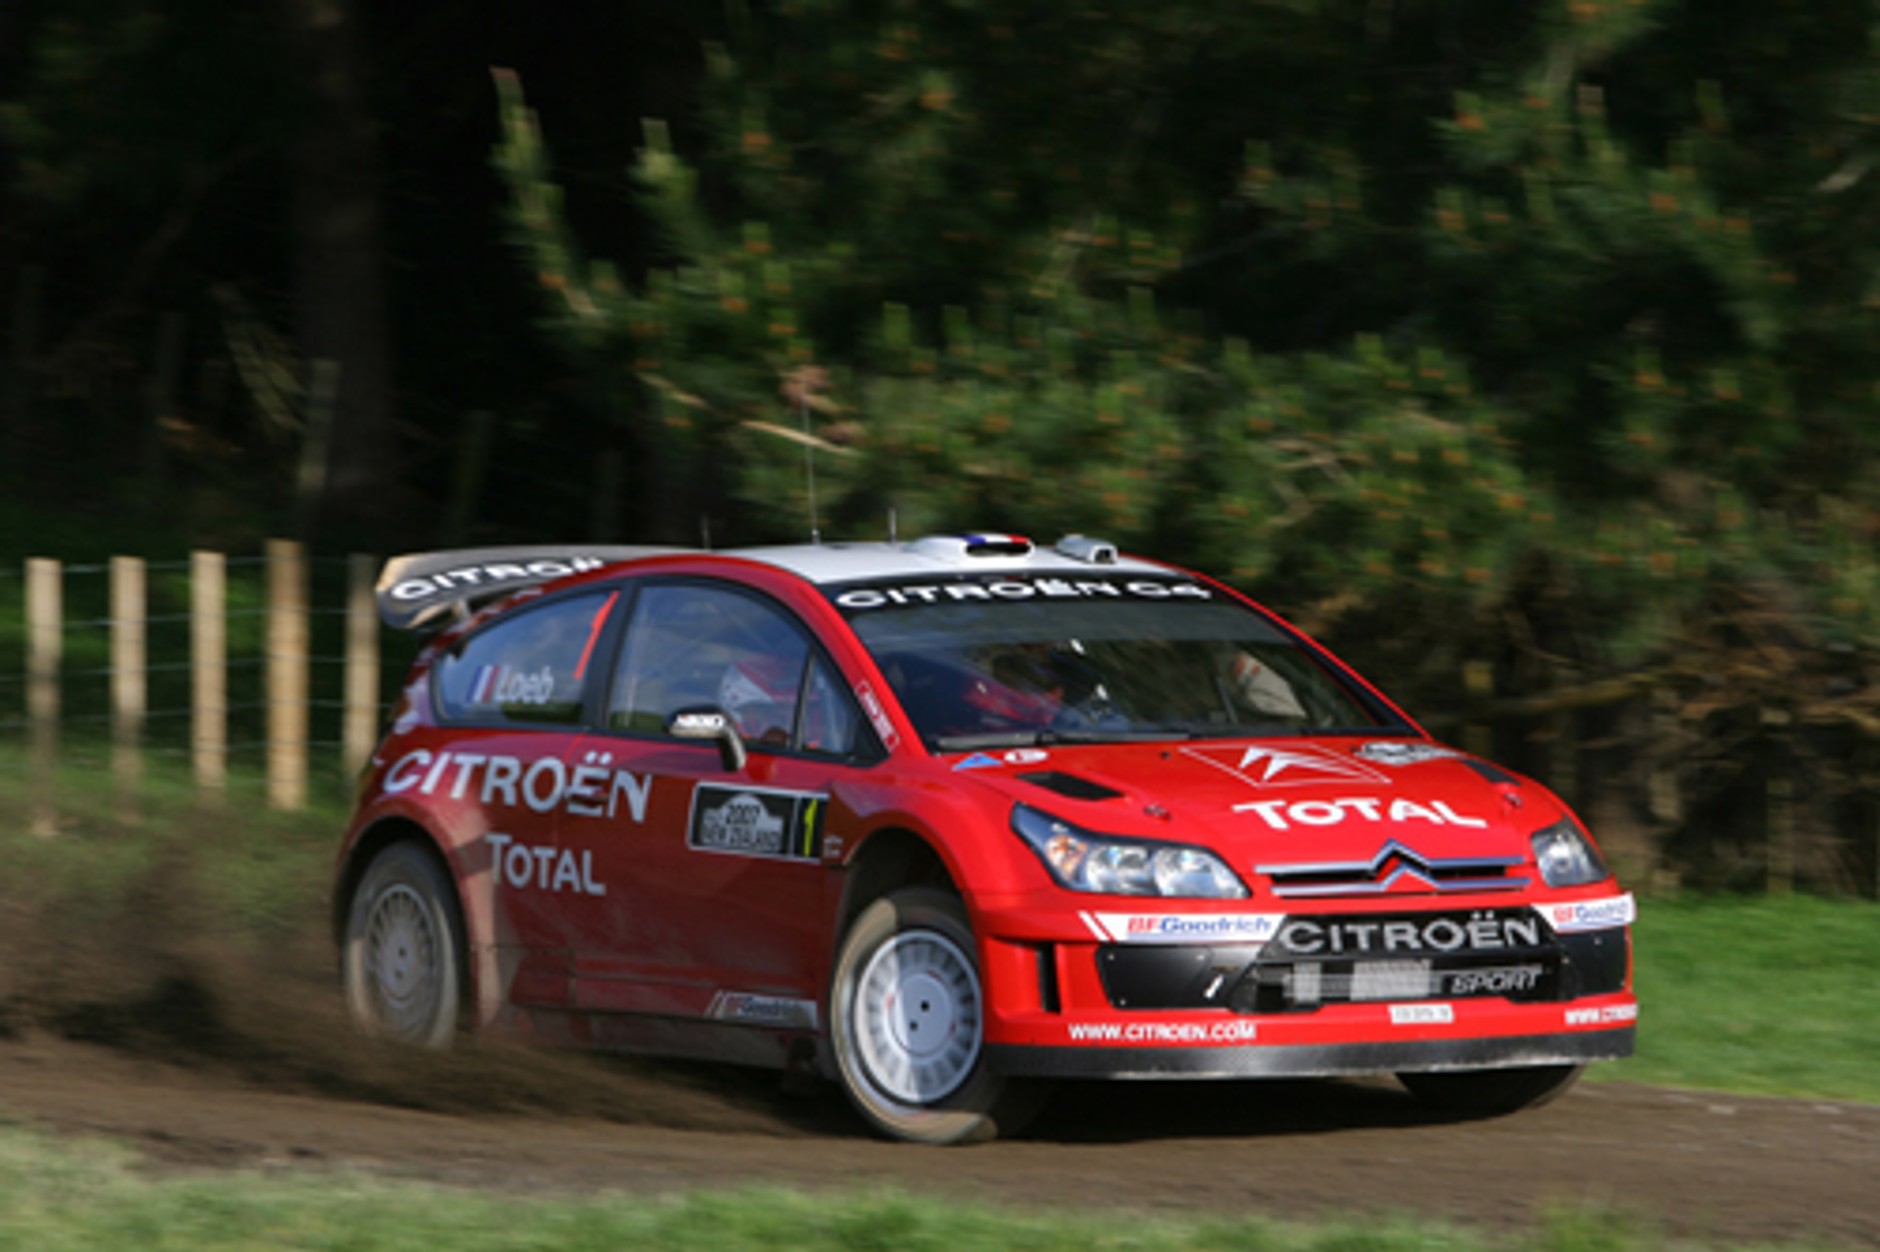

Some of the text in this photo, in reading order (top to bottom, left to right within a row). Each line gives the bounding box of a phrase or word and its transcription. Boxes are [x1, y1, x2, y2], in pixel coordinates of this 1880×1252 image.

[1126, 581, 1212, 600] C4
[494, 665, 555, 705] Loeb
[382, 748, 653, 824] CITROËN
[803, 798, 818, 858] 1
[1232, 797, 1488, 830] TOTAL
[1127, 916, 1273, 934] BFGoodrich
[1278, 910, 1541, 952] CITROËN
[1450, 968, 1542, 995] SPORT
[1068, 1020, 1256, 1041] WWW.CITROEN.COM
